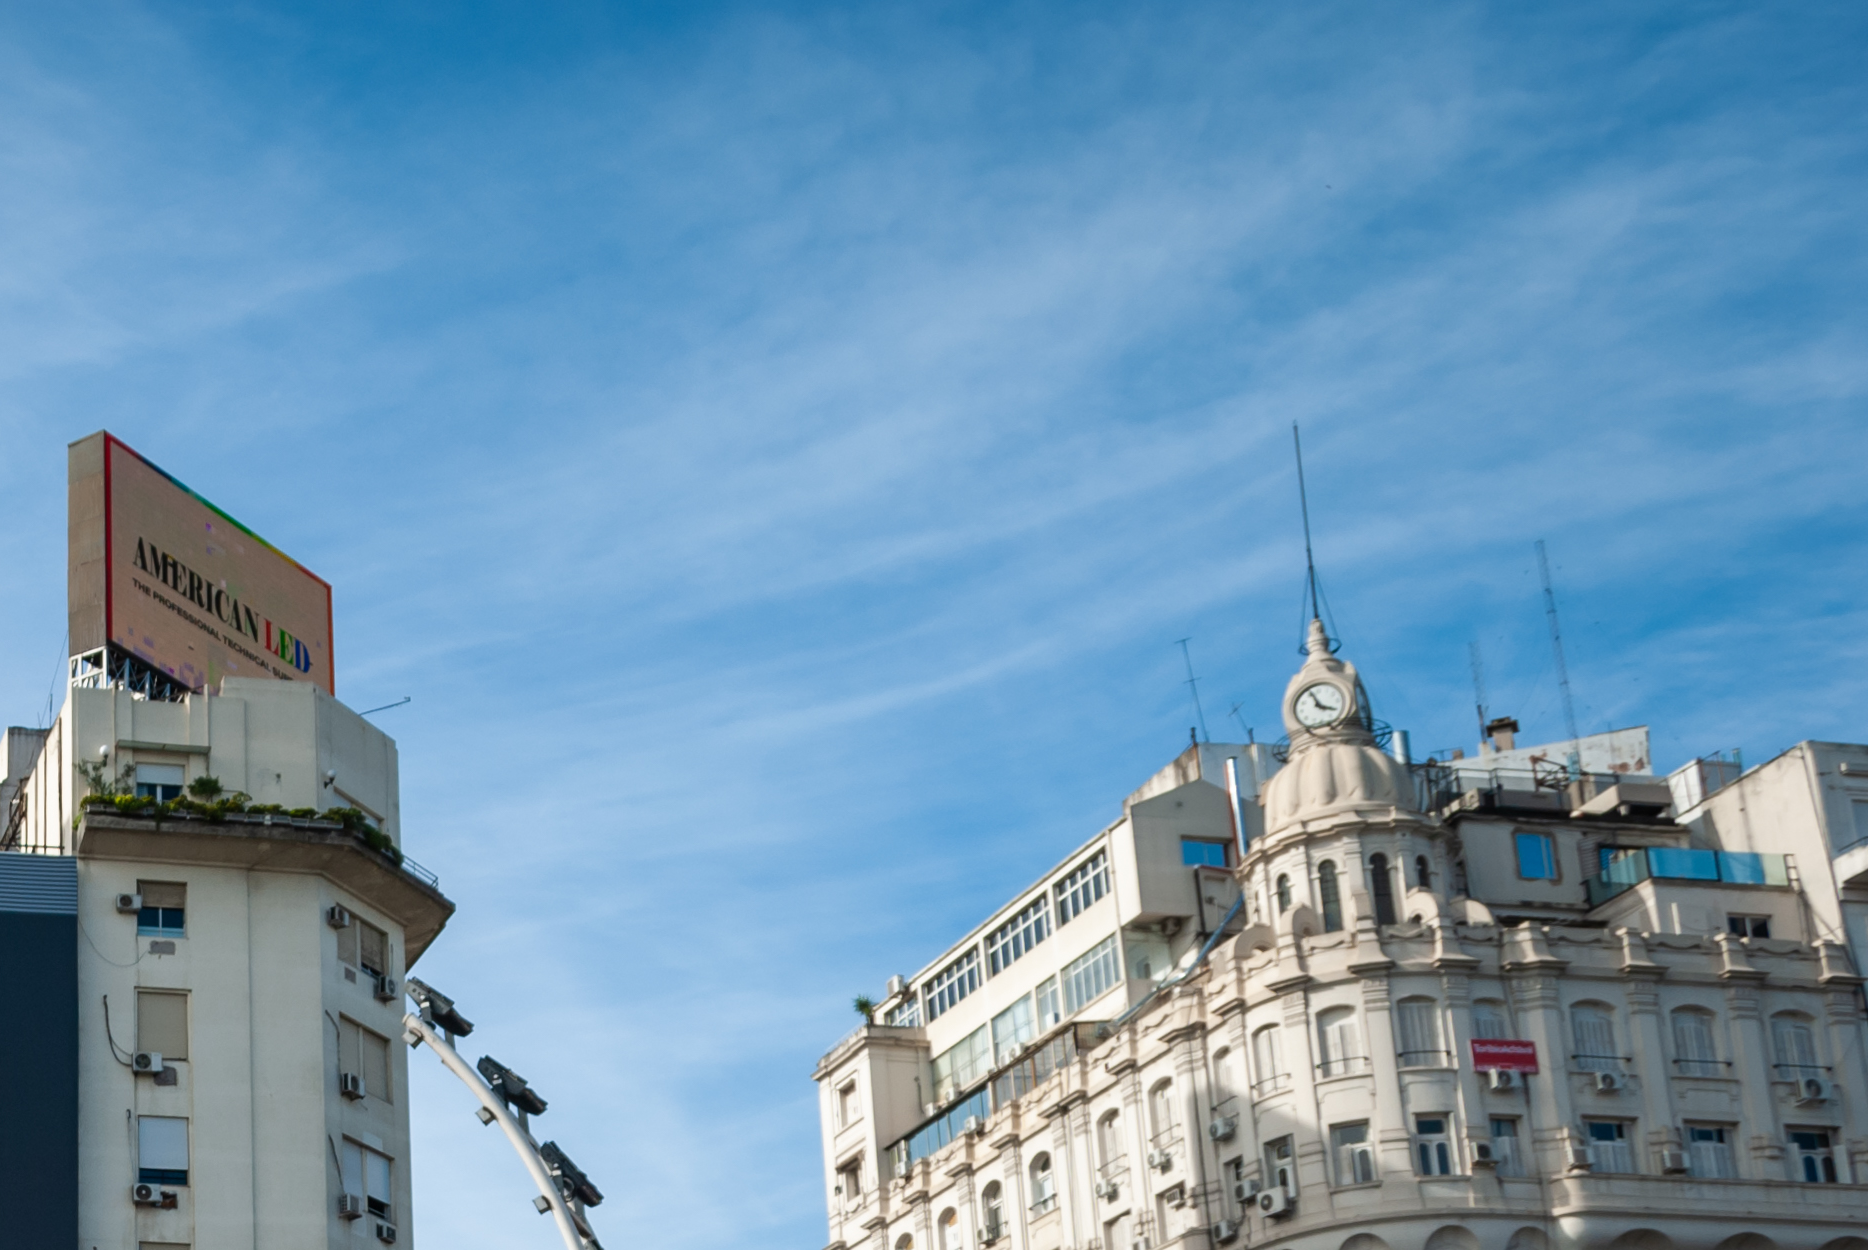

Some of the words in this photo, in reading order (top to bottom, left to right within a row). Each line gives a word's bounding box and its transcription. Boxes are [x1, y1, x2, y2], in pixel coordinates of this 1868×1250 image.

[132, 536, 259, 644] AMERICAN
[264, 617, 311, 674] LED
[132, 578, 152, 598] THE
[153, 590, 223, 642] PROFESSIONAL
[222, 635, 272, 673] TECHNICAL
